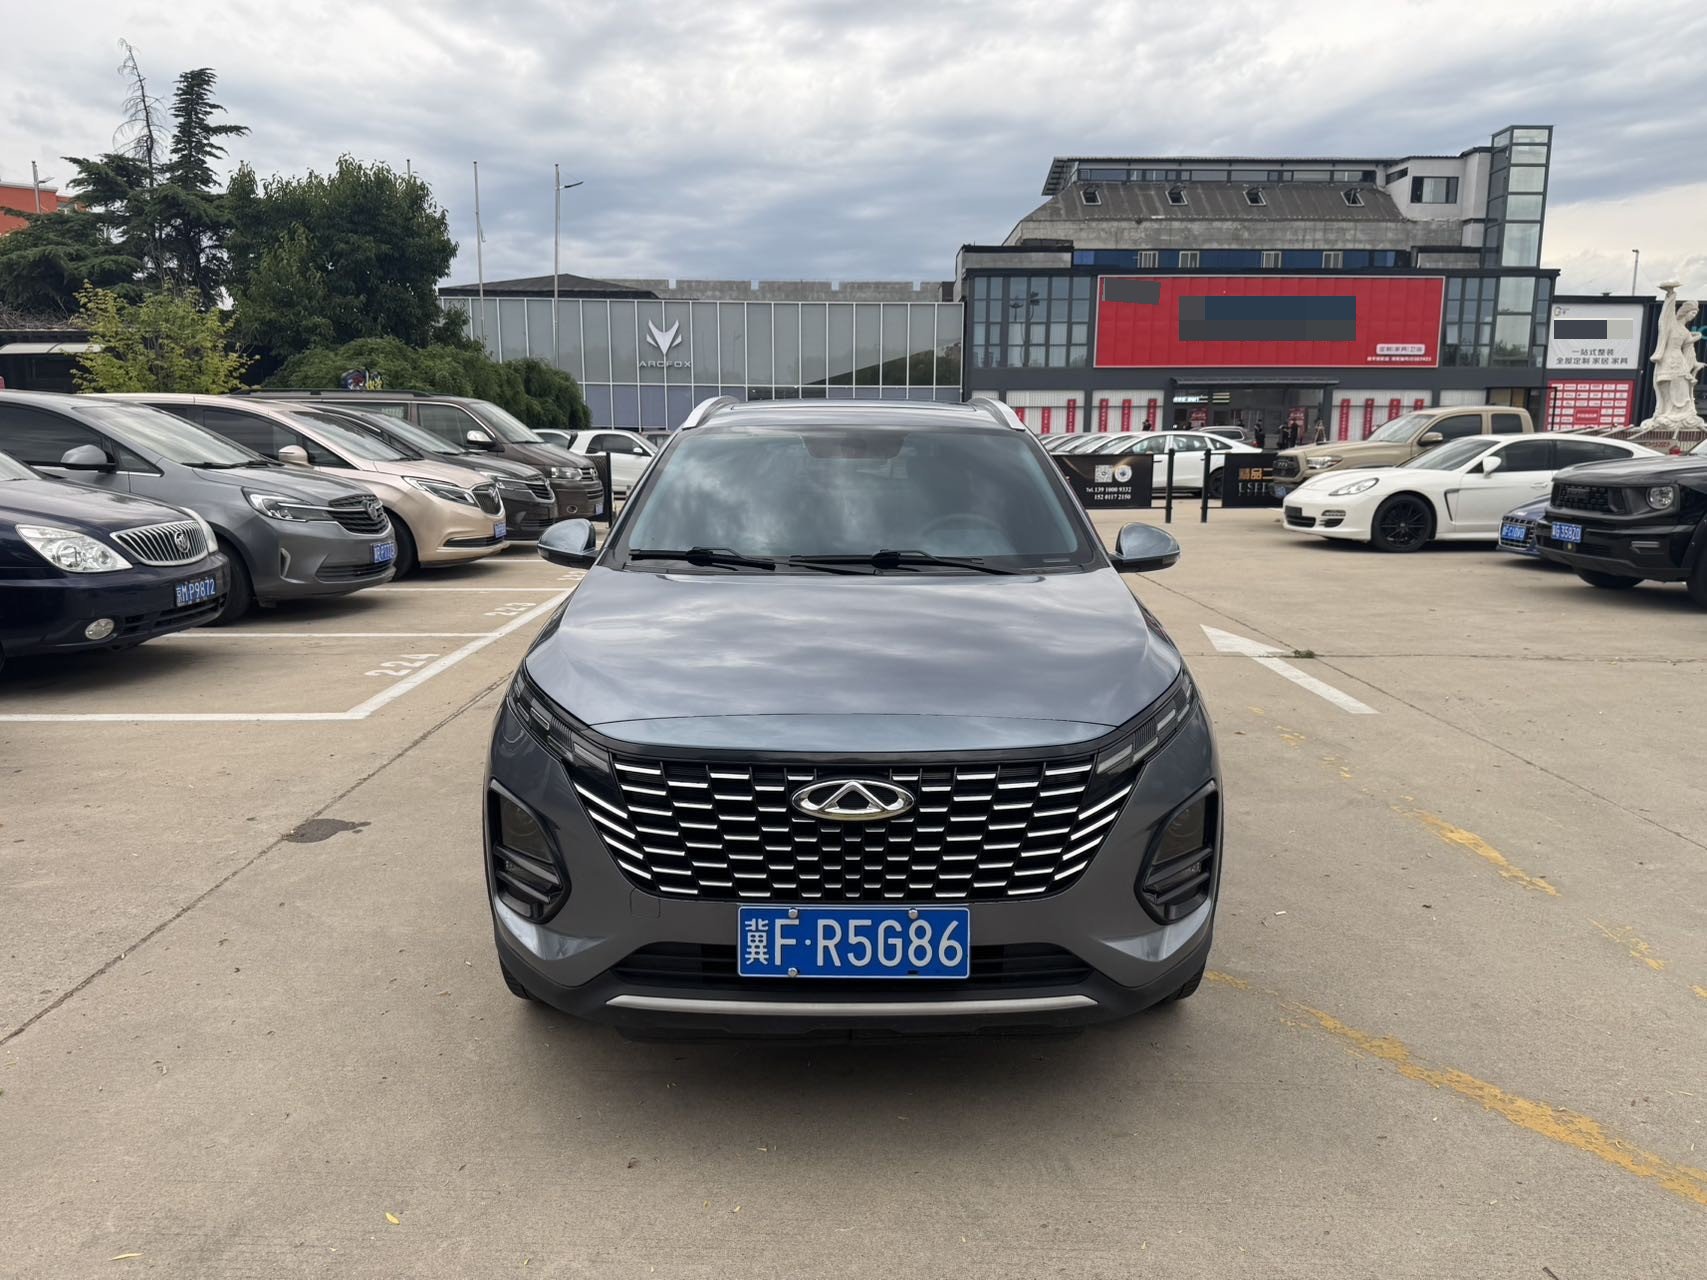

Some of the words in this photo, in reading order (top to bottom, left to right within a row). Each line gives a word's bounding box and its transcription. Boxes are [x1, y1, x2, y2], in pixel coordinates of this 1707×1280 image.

[639, 360, 691, 368] ARCFOX
[483, 602, 537, 617] 223
[364, 653, 440, 677] 224
[744, 918, 964, 968] 冀F·R5G86
